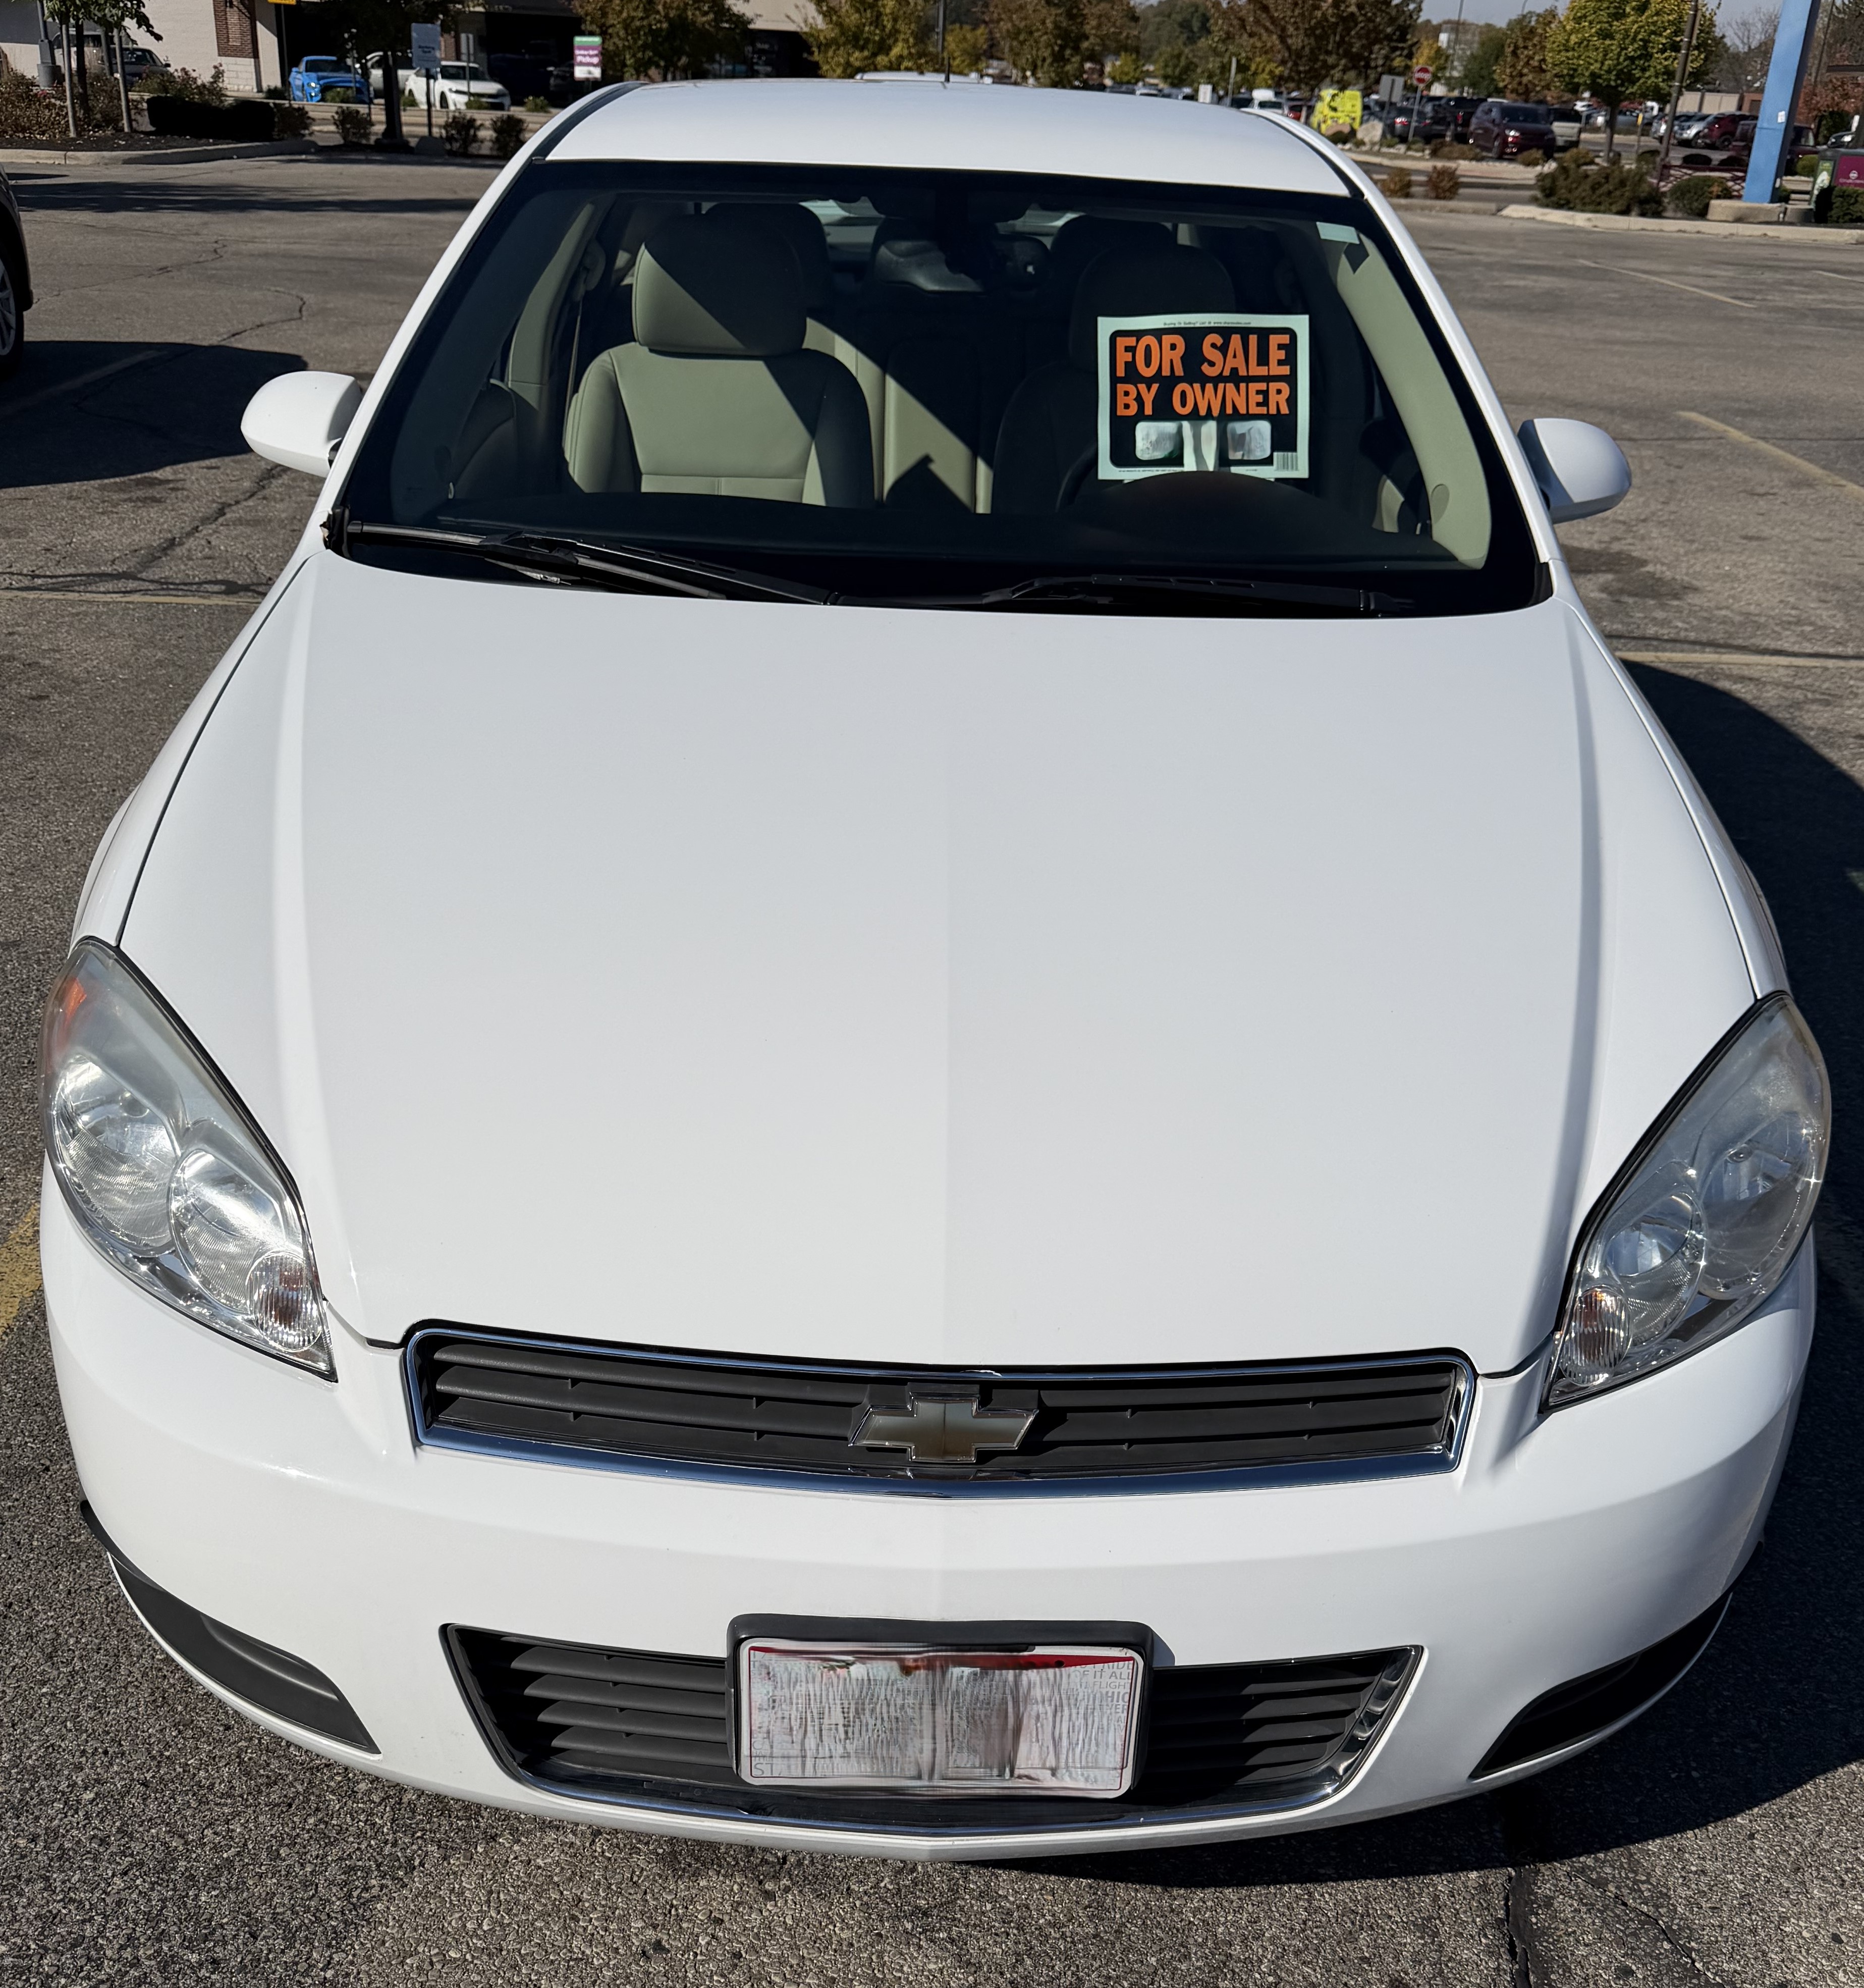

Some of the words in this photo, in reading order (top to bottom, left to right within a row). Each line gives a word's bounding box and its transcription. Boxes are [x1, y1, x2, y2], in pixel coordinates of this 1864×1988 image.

[1116, 335, 1185, 378] FOR
[1201, 334, 1290, 377] SALE
[1116, 383, 1159, 416] BY
[1172, 383, 1290, 416] OWNER
